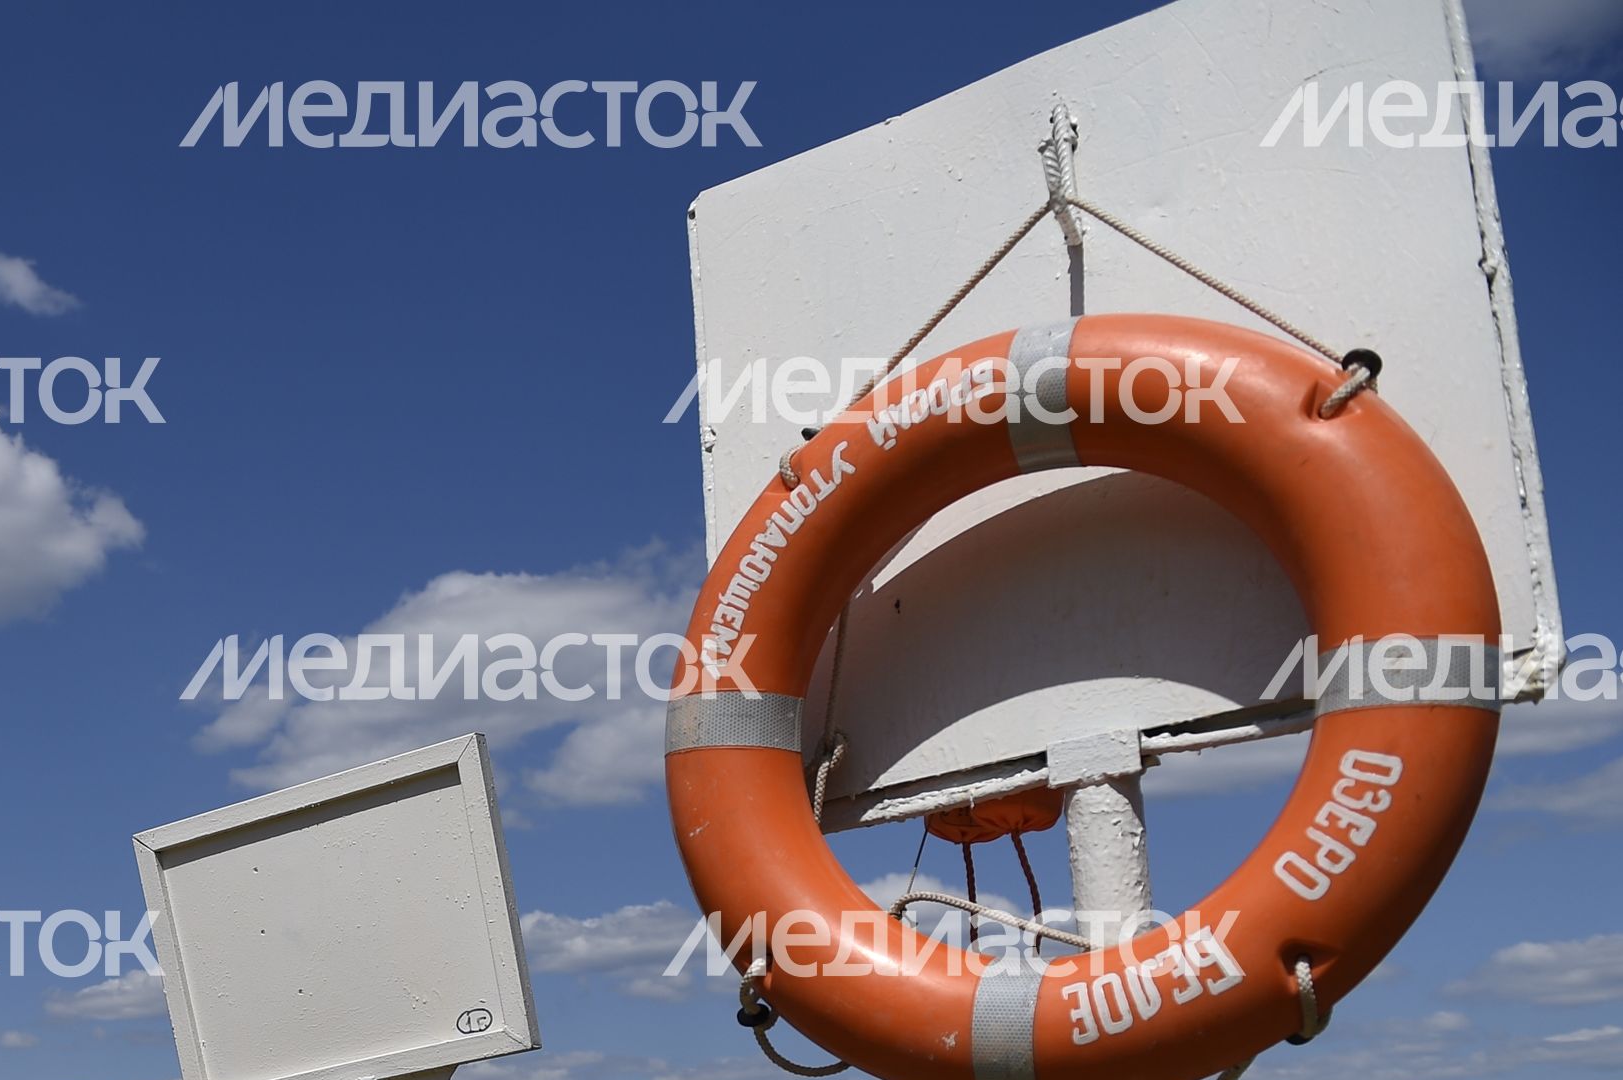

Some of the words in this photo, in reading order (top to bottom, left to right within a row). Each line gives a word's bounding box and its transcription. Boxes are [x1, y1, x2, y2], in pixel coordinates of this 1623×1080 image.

[866, 359, 994, 450] БРОСАЙ
[701, 440, 857, 680] УТОПАЮЩЕМУ
[1273, 749, 1403, 900] ОЗЕРО
[1062, 925, 1244, 1045] БЕЛОЕ
